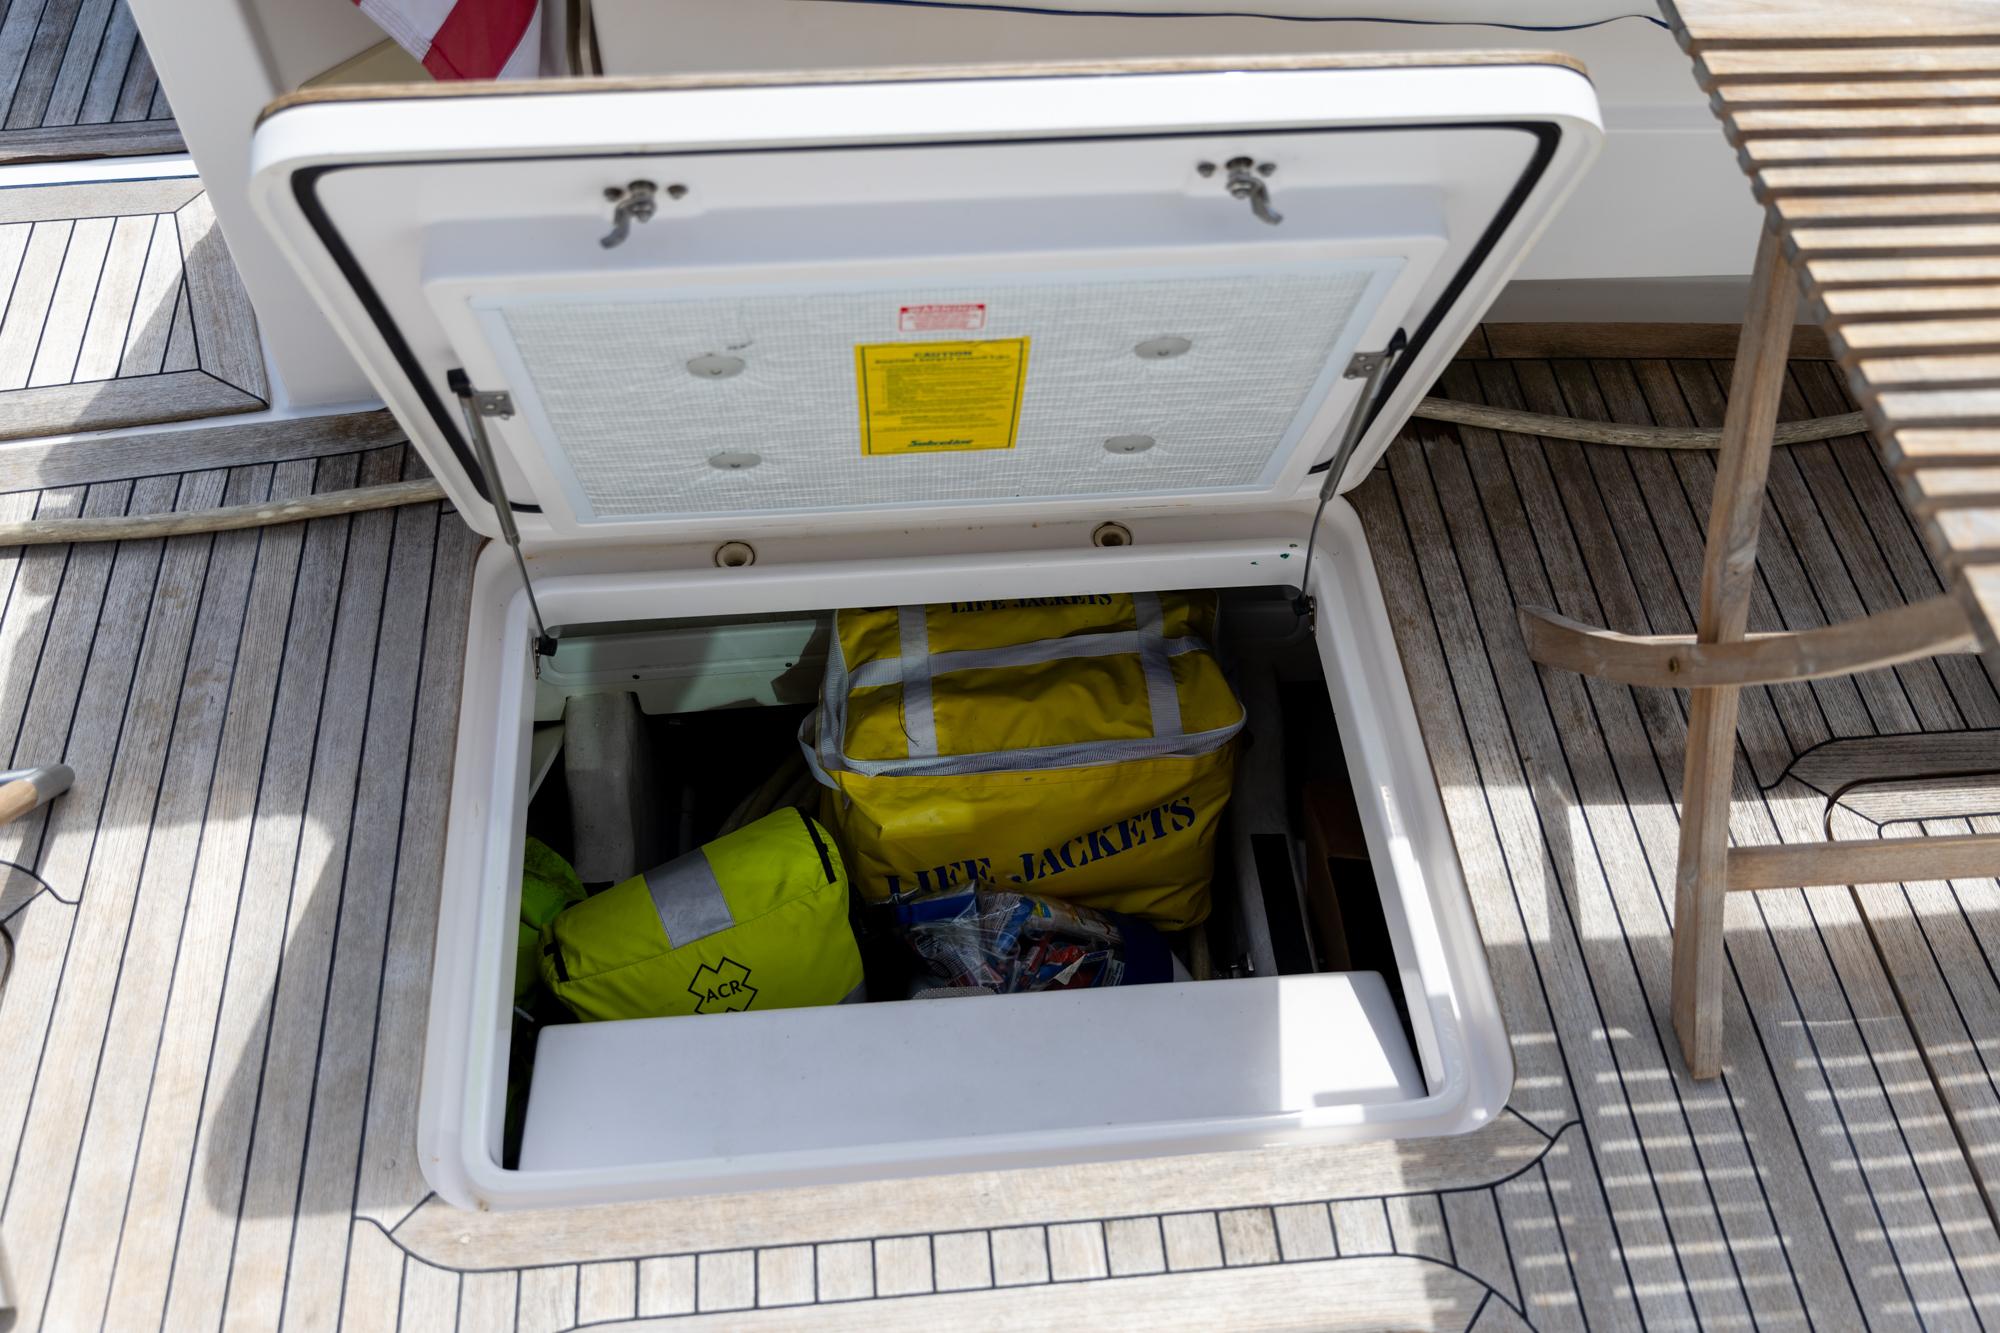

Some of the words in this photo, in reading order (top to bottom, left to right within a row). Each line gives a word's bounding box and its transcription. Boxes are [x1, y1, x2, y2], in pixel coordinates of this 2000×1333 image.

[914, 350, 973, 358] CAUTION
[1010, 797, 1196, 883] JACKETS
[706, 980, 742, 1003] ACR
